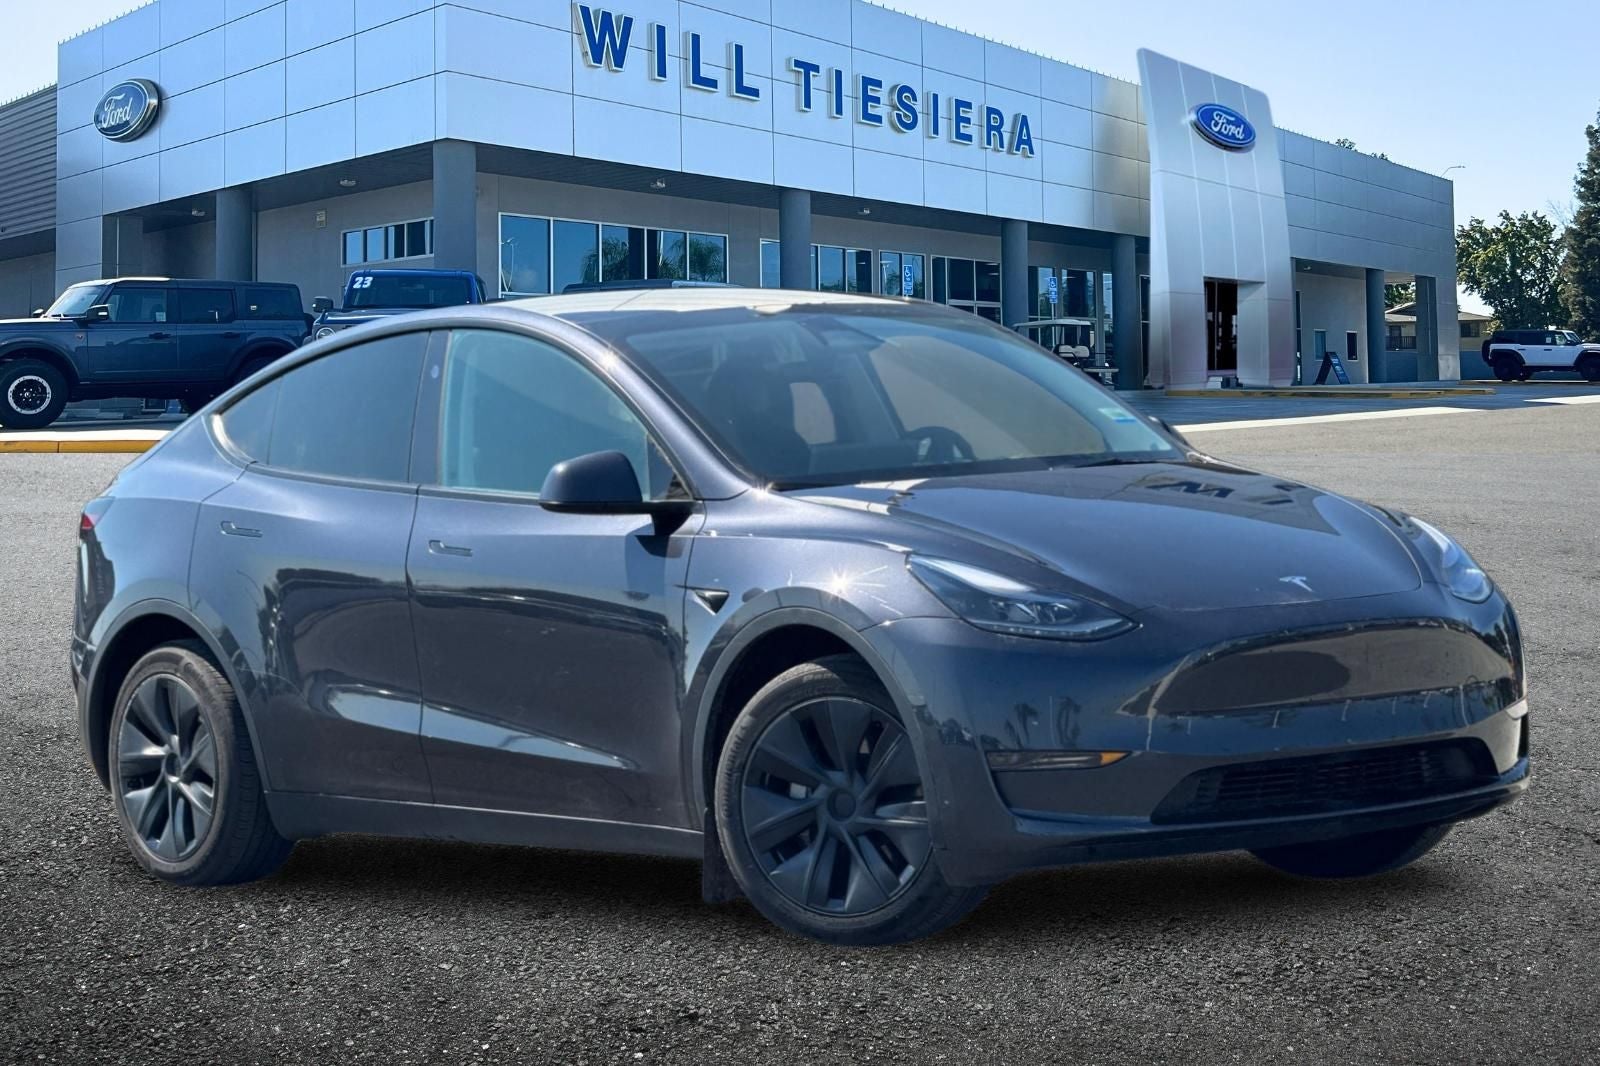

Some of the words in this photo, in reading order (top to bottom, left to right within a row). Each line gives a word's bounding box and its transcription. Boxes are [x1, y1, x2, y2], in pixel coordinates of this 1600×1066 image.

[576, 3, 760, 100] WILL
[789, 57, 1035, 157] TIESIERA
[101, 93, 133, 129] Ford
[1211, 111, 1245, 139] Ford
[353, 276, 373, 289] 23
